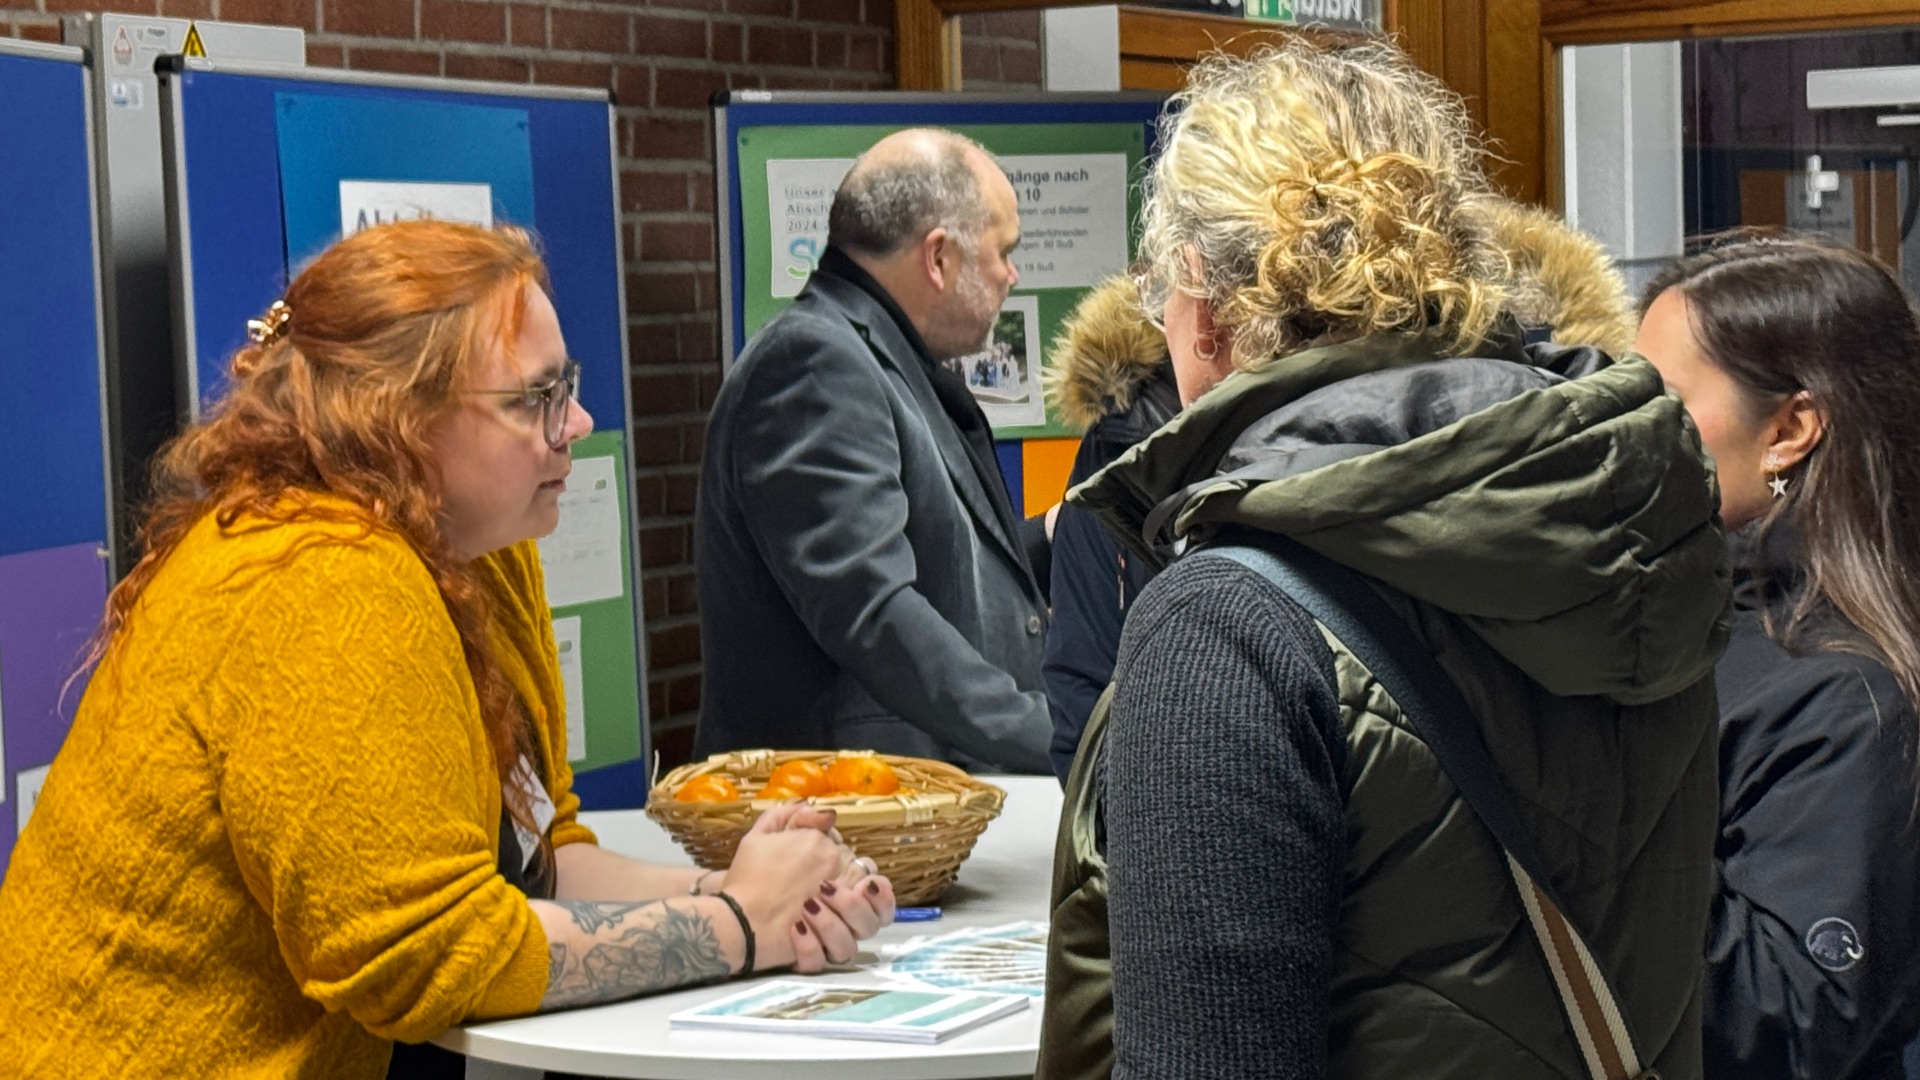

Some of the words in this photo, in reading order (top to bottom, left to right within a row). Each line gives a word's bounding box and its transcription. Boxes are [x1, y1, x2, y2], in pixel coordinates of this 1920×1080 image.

[1054, 168, 1089, 182] nach
[1026, 187, 1041, 202] 10
[788, 220, 817, 231] 2024
